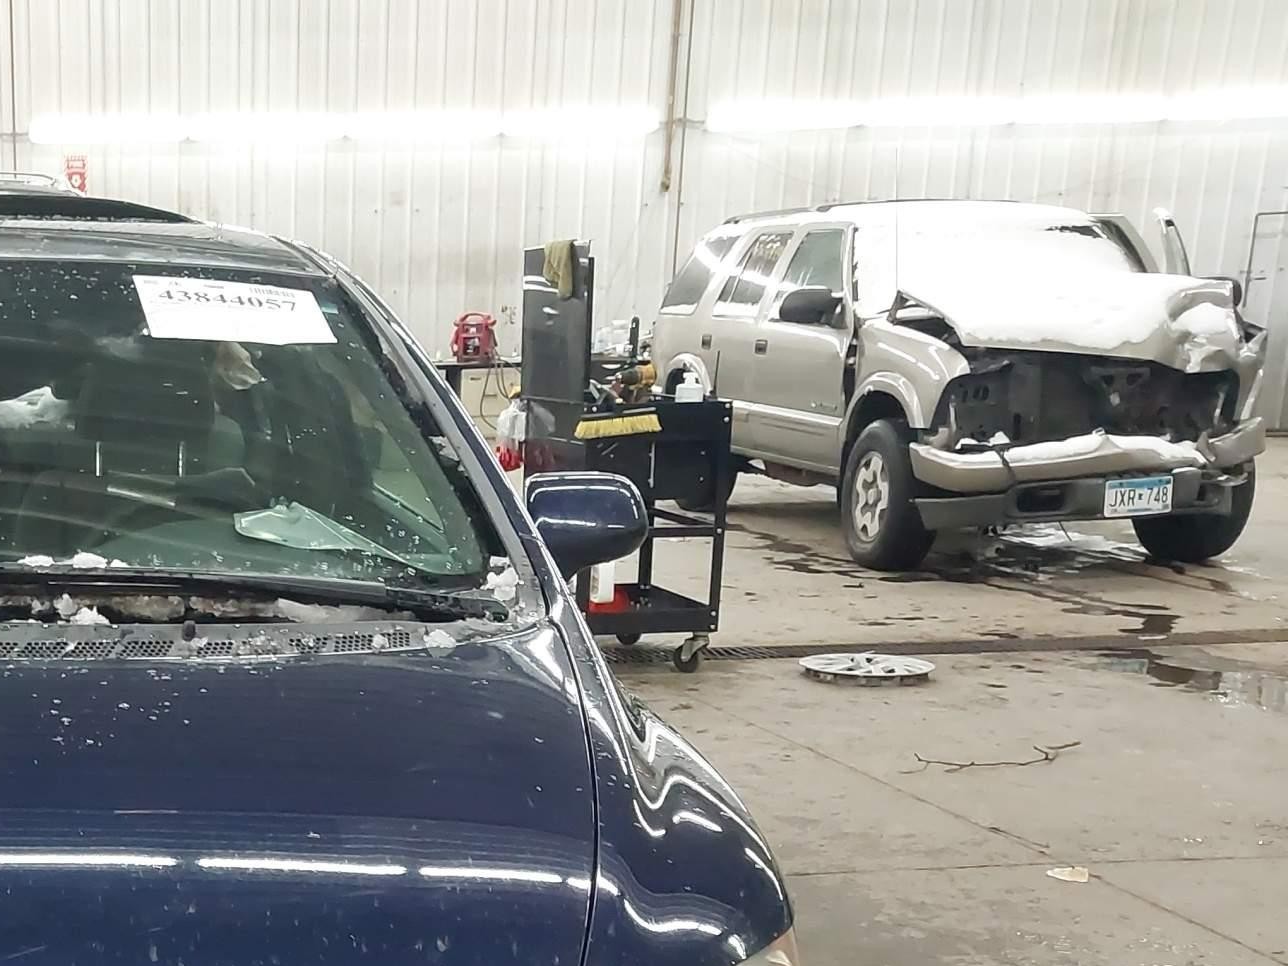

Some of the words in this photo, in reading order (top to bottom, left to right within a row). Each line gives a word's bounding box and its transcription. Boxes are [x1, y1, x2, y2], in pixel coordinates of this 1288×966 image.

[158, 288, 297, 312] 43844057
[1108, 488, 1136, 507] JXR
[1146, 486, 1169, 505] 748
